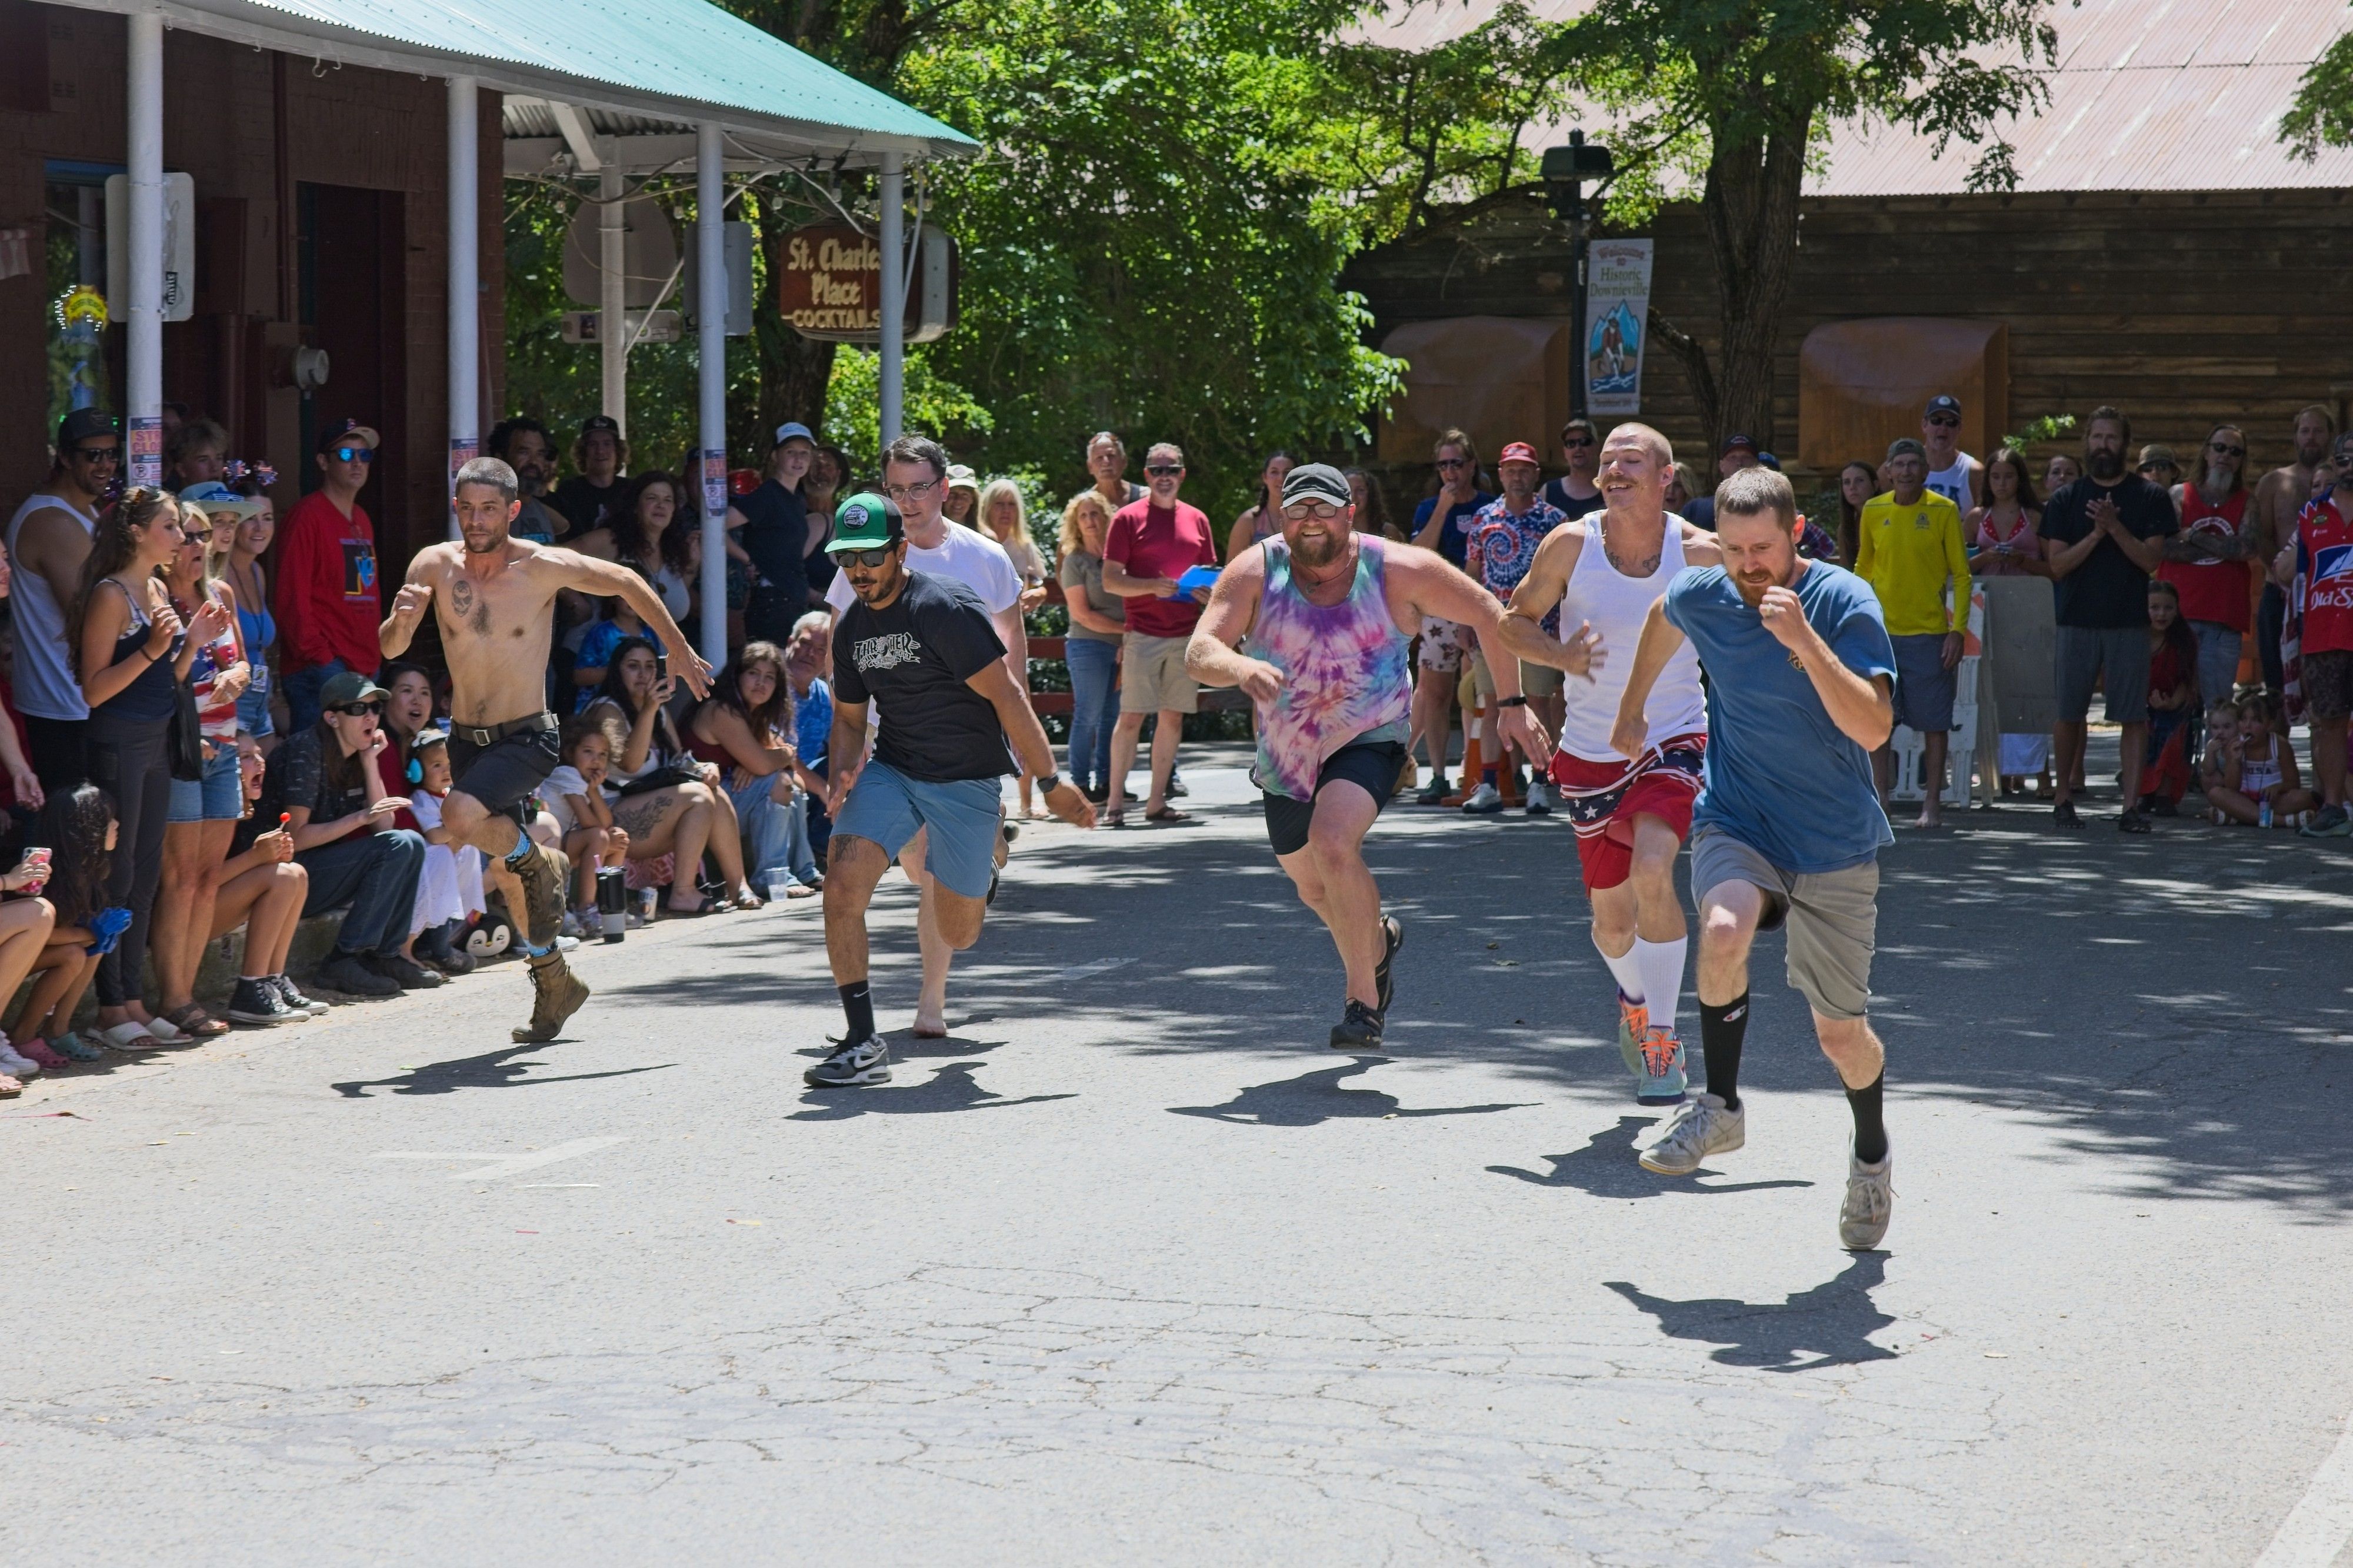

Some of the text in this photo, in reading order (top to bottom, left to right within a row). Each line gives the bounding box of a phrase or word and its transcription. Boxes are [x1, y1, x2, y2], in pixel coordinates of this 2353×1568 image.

[788, 236, 881, 271] St. Charle
[1601, 267, 1642, 281] Historic
[811, 271, 861, 305] Place
[1589, 282, 1648, 296] Downieville
